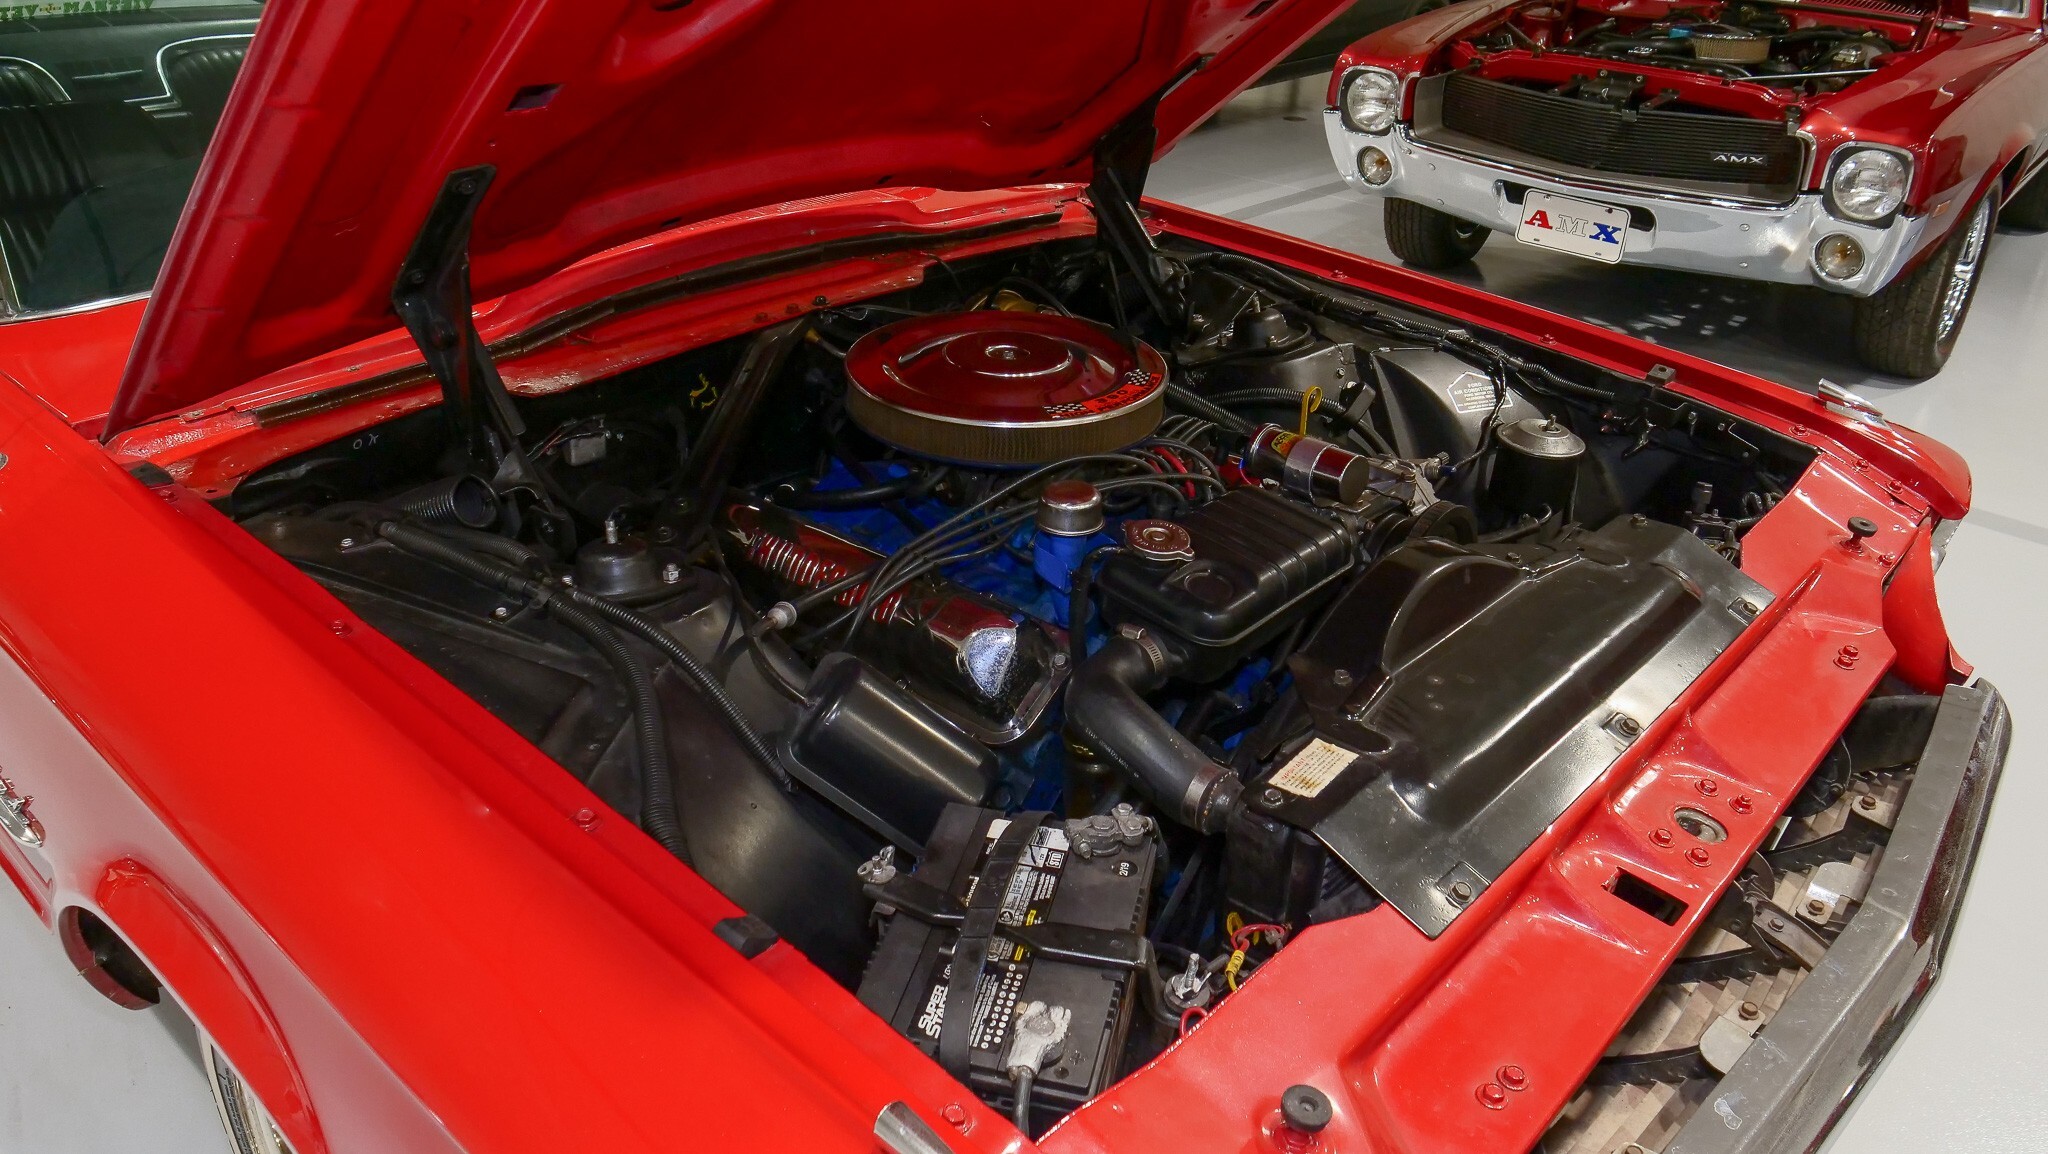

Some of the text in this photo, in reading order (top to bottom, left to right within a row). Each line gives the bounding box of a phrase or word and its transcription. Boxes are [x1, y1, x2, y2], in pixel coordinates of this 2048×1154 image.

[1713, 153, 1765, 165] AMX
[1524, 209, 1622, 245] AMX
[1049, 852, 1064, 868] STD
[1118, 862, 1130, 877] 2/19
[918, 984, 945, 1030] SUPER
